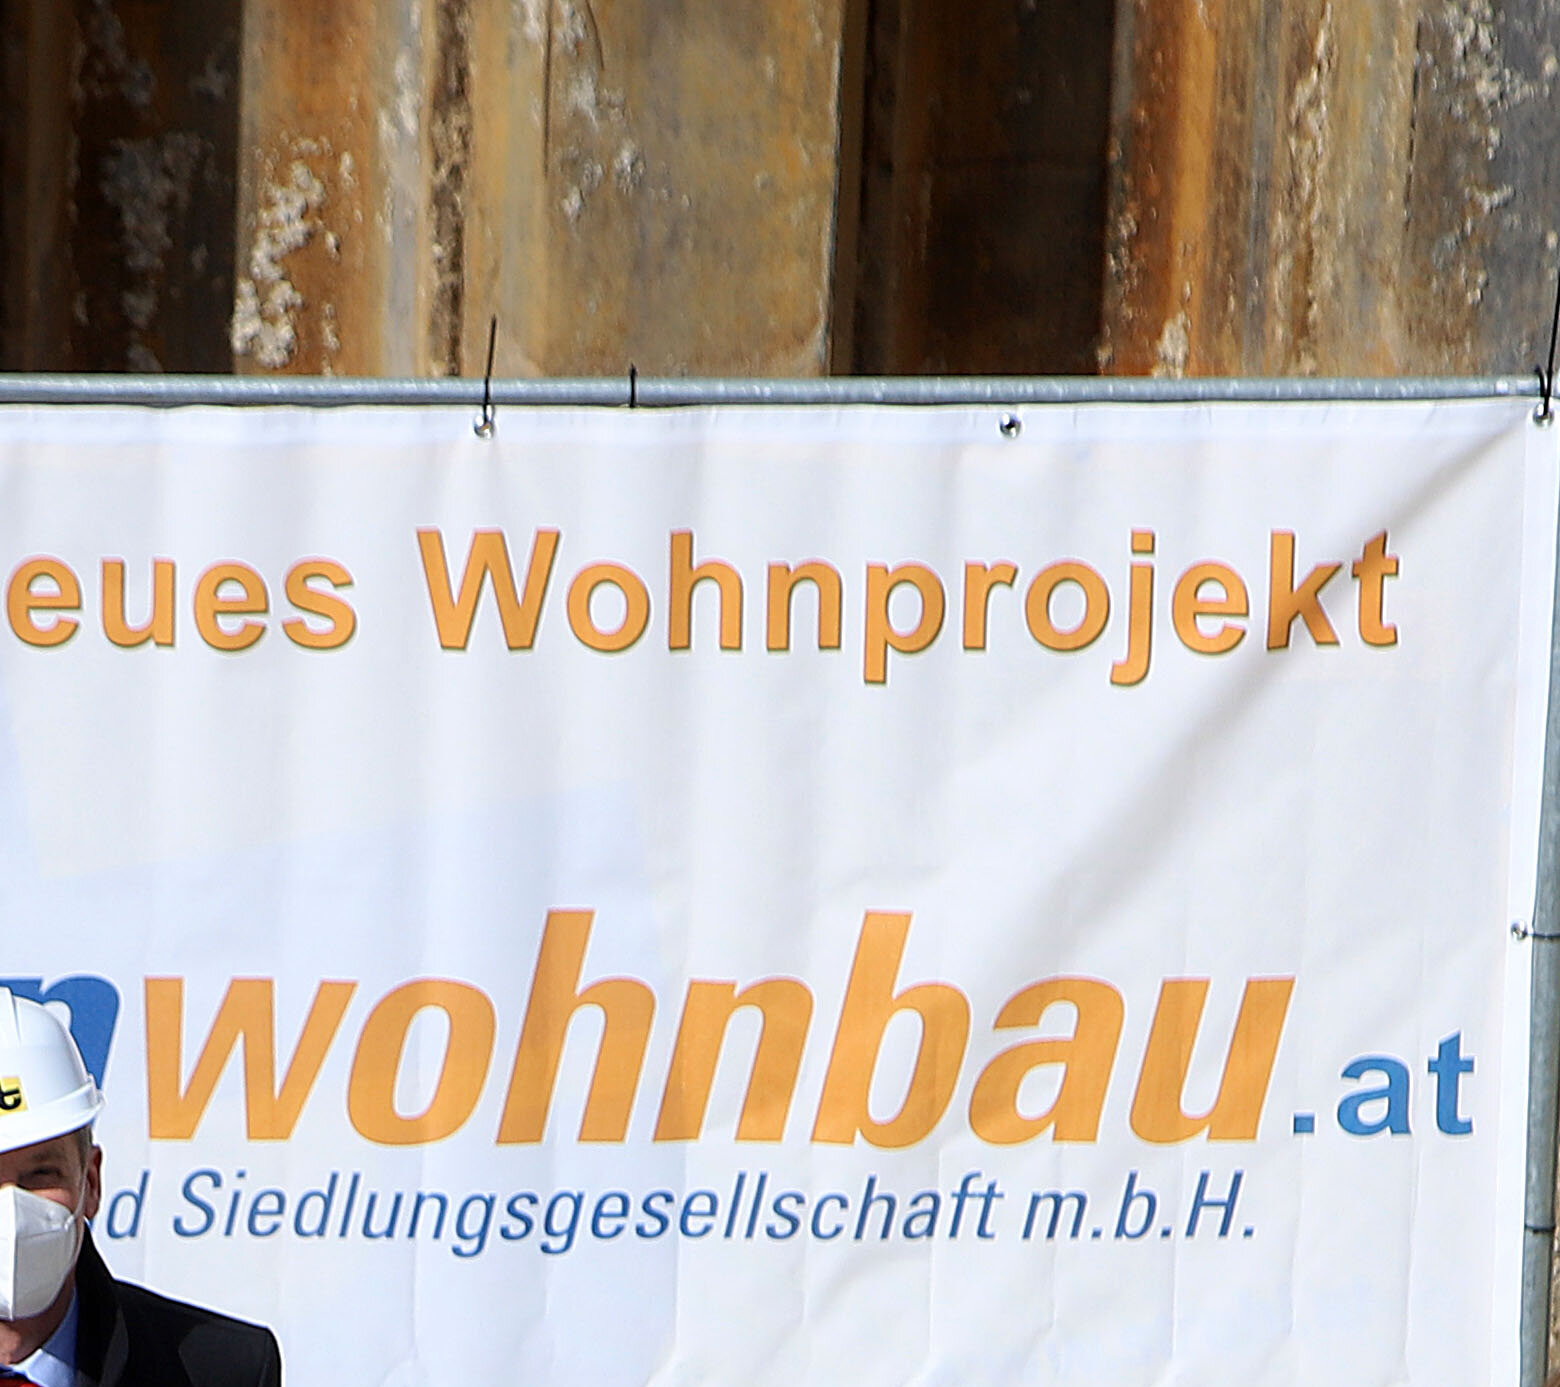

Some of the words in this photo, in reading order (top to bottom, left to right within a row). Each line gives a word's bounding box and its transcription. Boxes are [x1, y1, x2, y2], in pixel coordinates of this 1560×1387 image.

[416, 527, 1402, 688] Wohnprojekt
[170, 1168, 1006, 1256] Siedlungsgesellschaft
[1020, 1171, 1258, 1241] m.b.H.
